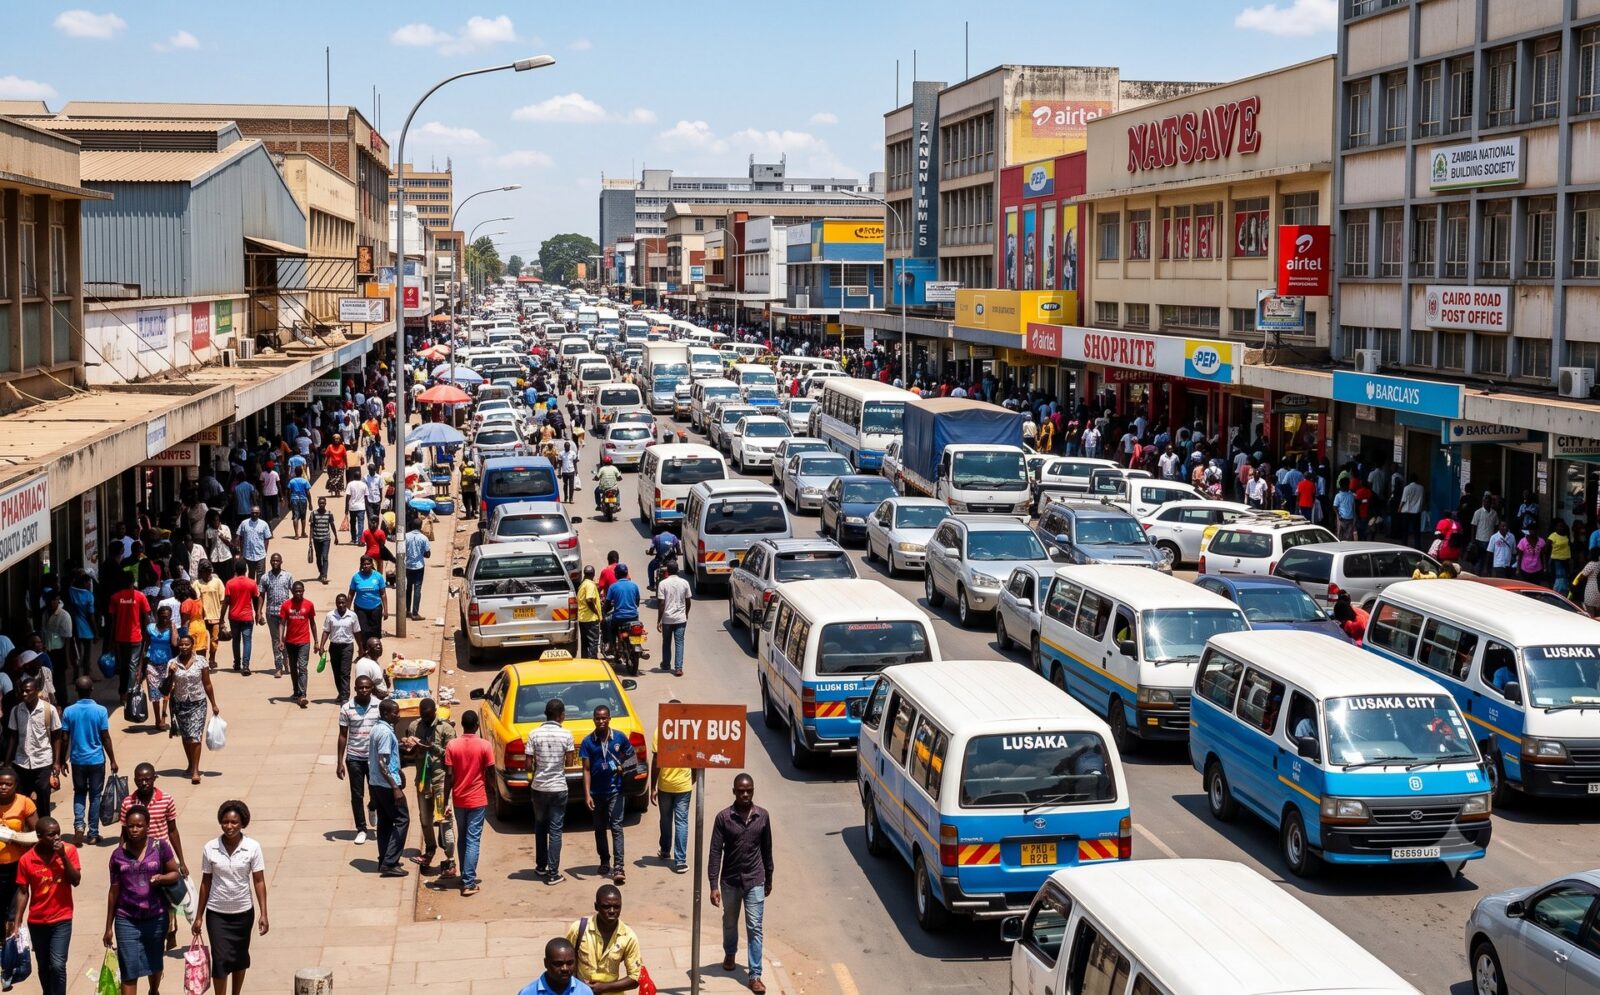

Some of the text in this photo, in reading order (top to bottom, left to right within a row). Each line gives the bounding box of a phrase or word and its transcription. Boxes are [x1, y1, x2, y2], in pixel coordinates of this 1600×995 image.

[1055, 106, 1103, 126] airtel
[1127, 96, 1261, 172] NATSAVE
[1451, 145, 1515, 164] ZAMBIA NATIONAL
[1031, 171, 1046, 186] PEP
[1451, 160, 1516, 179] BUILDING SOCIETY
[918, 122, 929, 246] ZANDNIMMES
[1286, 256, 1322, 271] airtel
[1442, 292, 1501, 307] CAIRO ROAD
[1441, 309, 1503, 325] POST OFFICE
[1038, 332, 1056, 351] airtel
[1084, 333, 1155, 368] SHOPRITE
[1195, 351, 1217, 368] PEP
[1376, 384, 1420, 405] BARCLAYS
[1558, 436, 1584, 447] CITY
[2, 481, 47, 530] PHARMACY
[1543, 647, 1595, 658] LUSAKA
[1349, 697, 1436, 710] LUSAKA CITY
[662, 719, 741, 741] CITY BUS
[1002, 735, 1068, 750] LUSAKA
